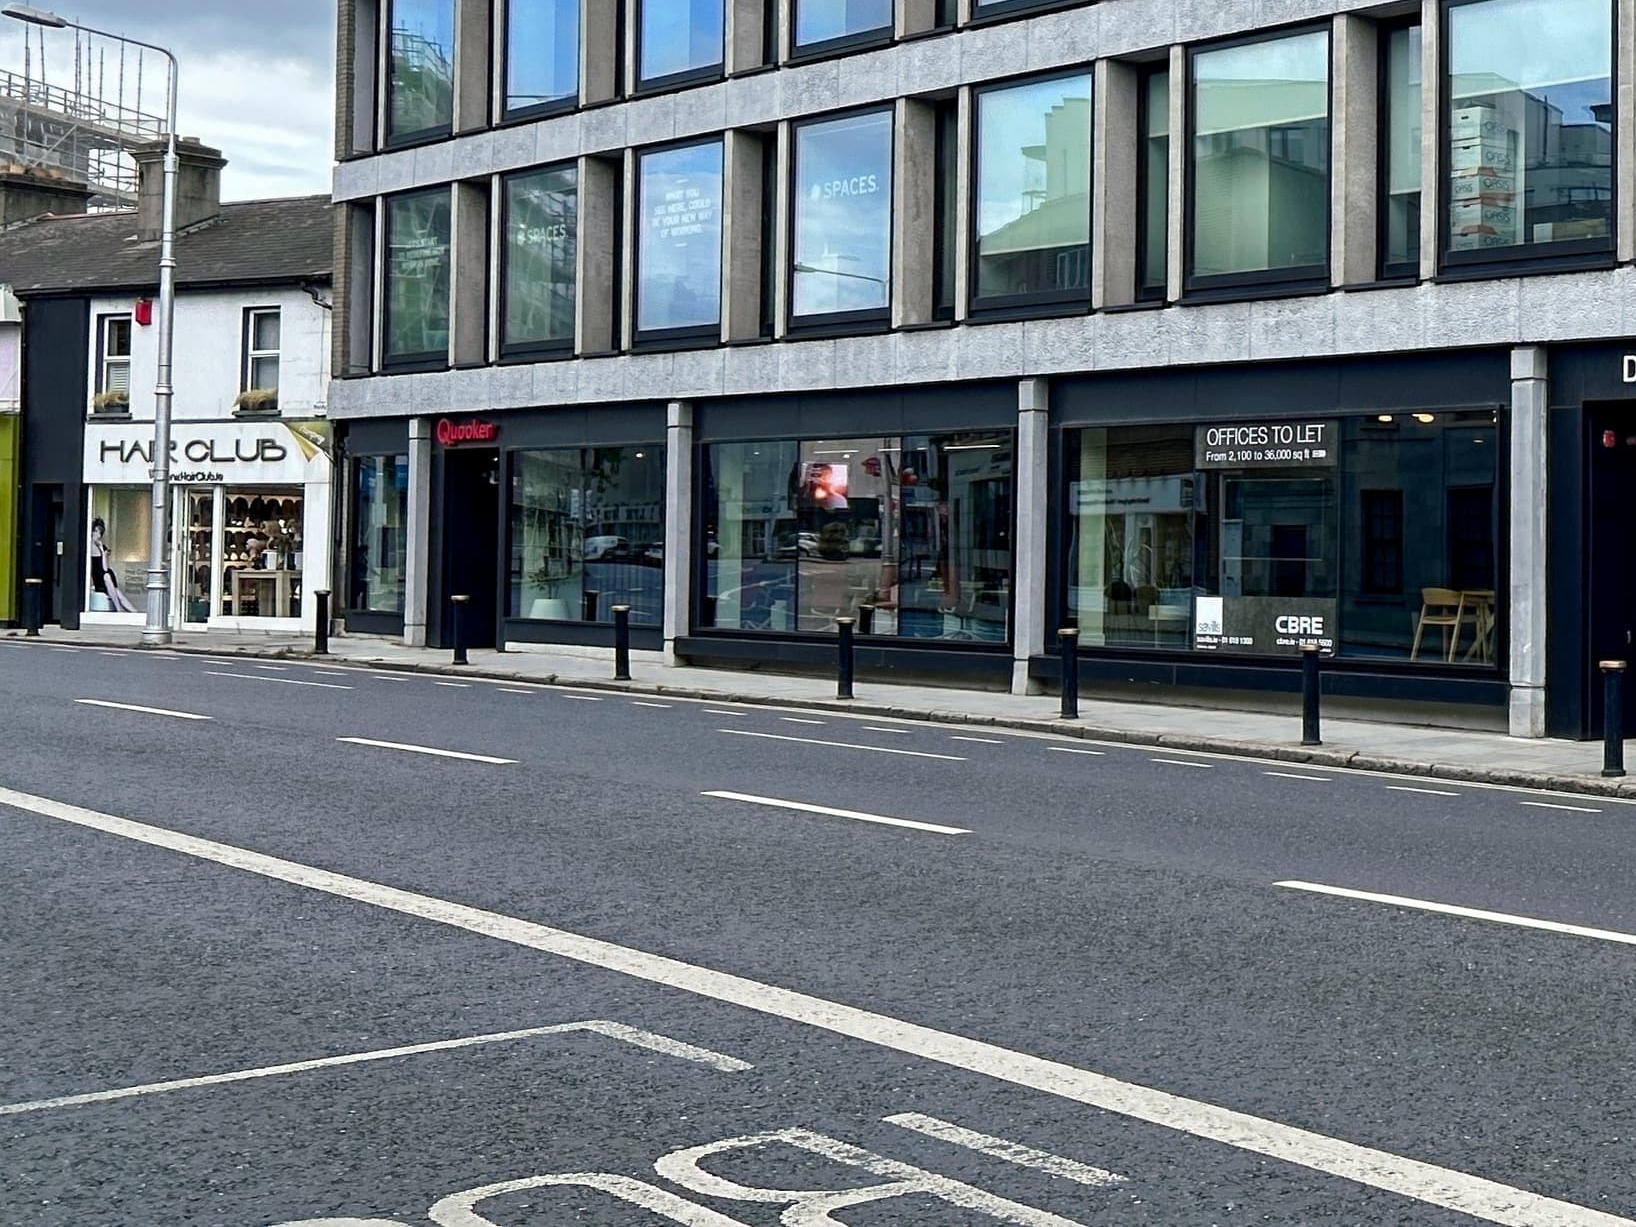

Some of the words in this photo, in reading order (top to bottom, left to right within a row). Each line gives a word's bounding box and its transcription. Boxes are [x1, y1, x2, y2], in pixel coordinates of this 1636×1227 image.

[824, 174, 880, 198] SPACES.
[436, 417, 493, 445] Quooker
[1206, 426, 1268, 446] OFFICES
[1271, 425, 1293, 444] TO
[1296, 424, 1326, 443] LET
[185, 437, 288, 463] CLUB
[1206, 451, 1227, 461] From
[1228, 450, 1252, 461] 2,100
[1253, 451, 1263, 460] to
[1292, 450, 1303, 461] sq
[1275, 615, 1324, 635] CBRE
